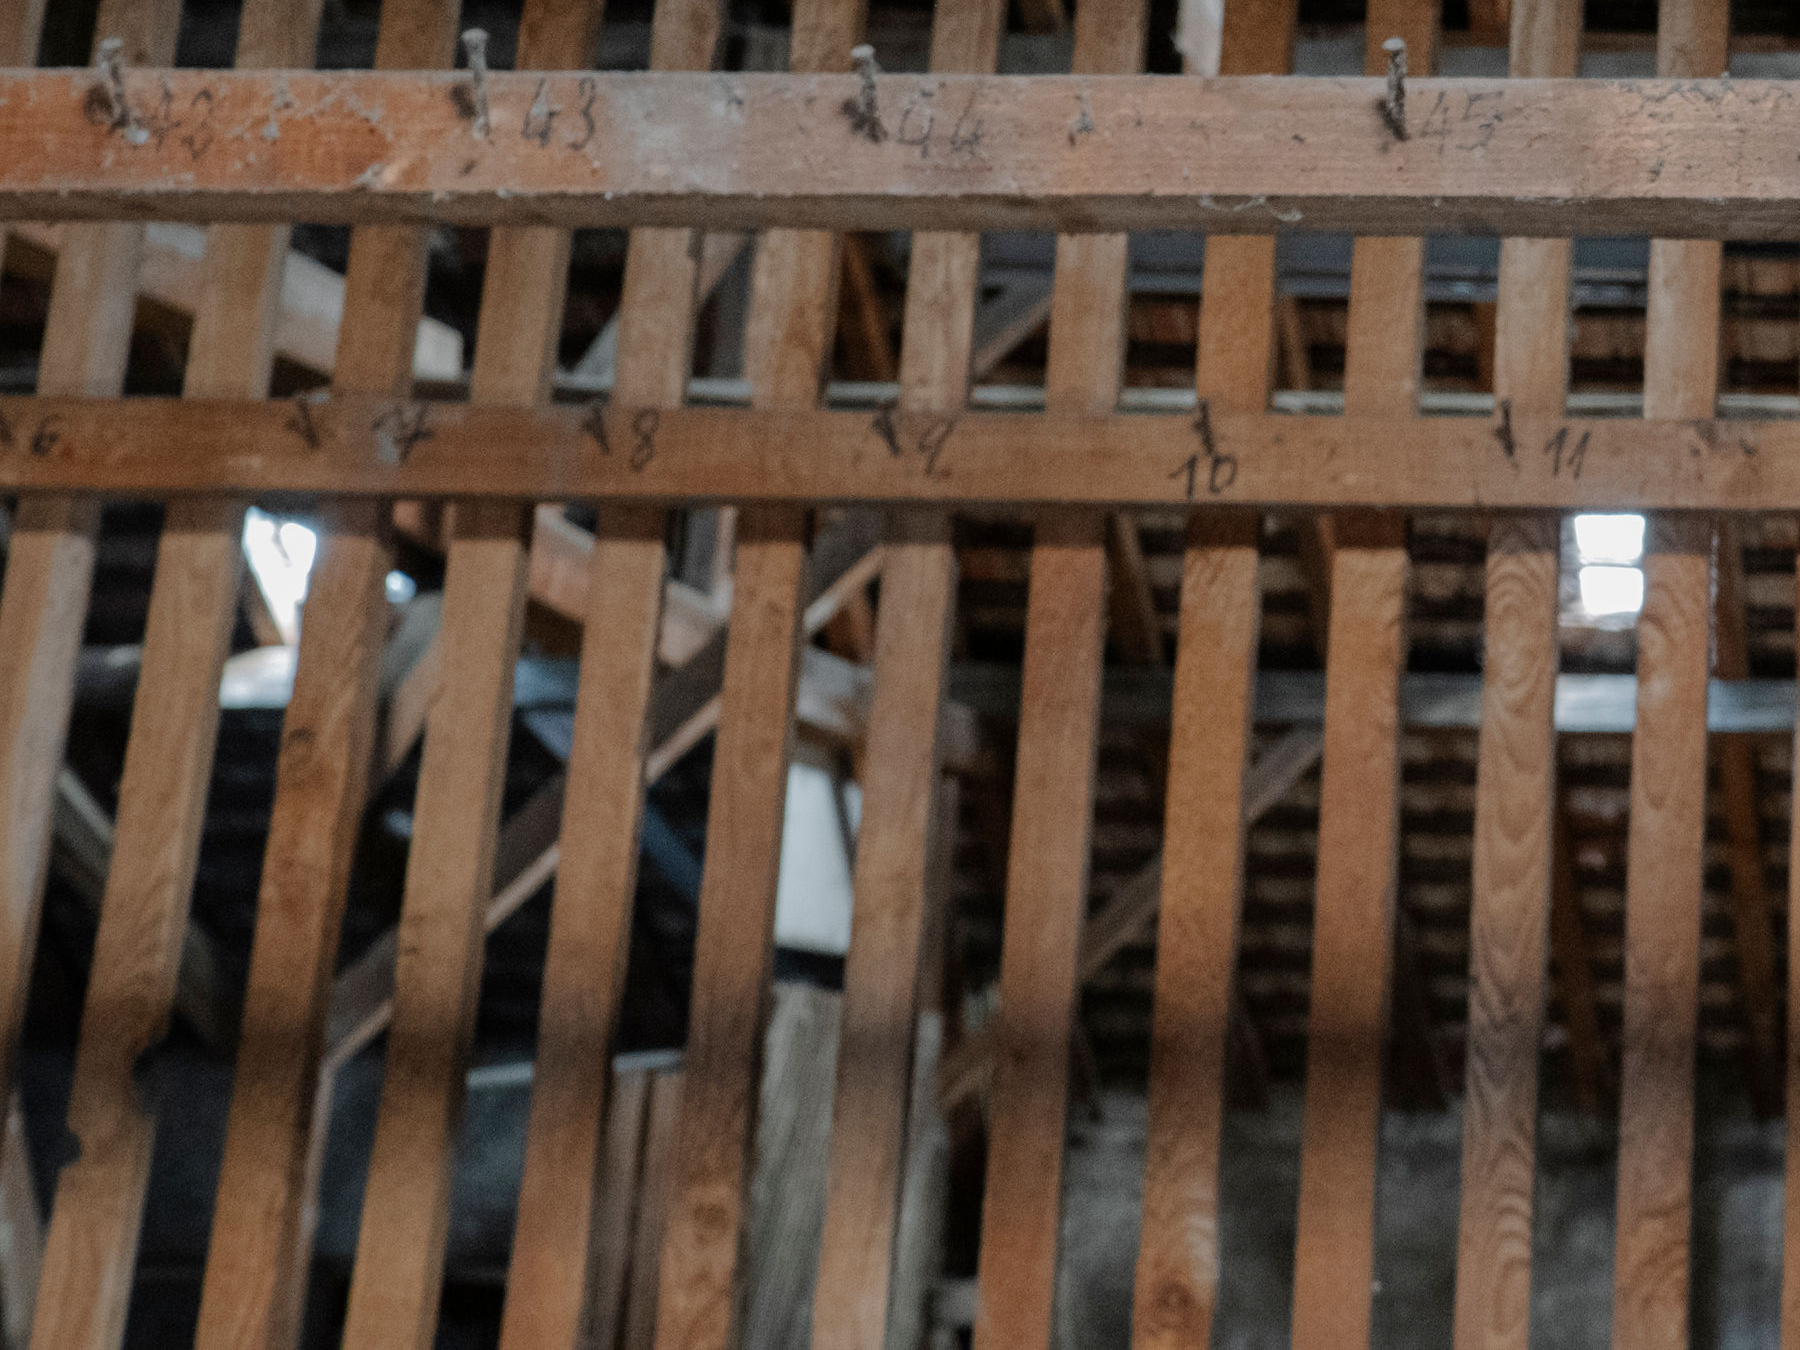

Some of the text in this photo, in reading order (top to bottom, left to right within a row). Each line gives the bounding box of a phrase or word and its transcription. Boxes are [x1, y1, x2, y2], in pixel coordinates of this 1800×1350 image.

[628, 406, 661, 473] 8
[1544, 425, 1592, 481] 11
[1167, 452, 1239, 501] 10
